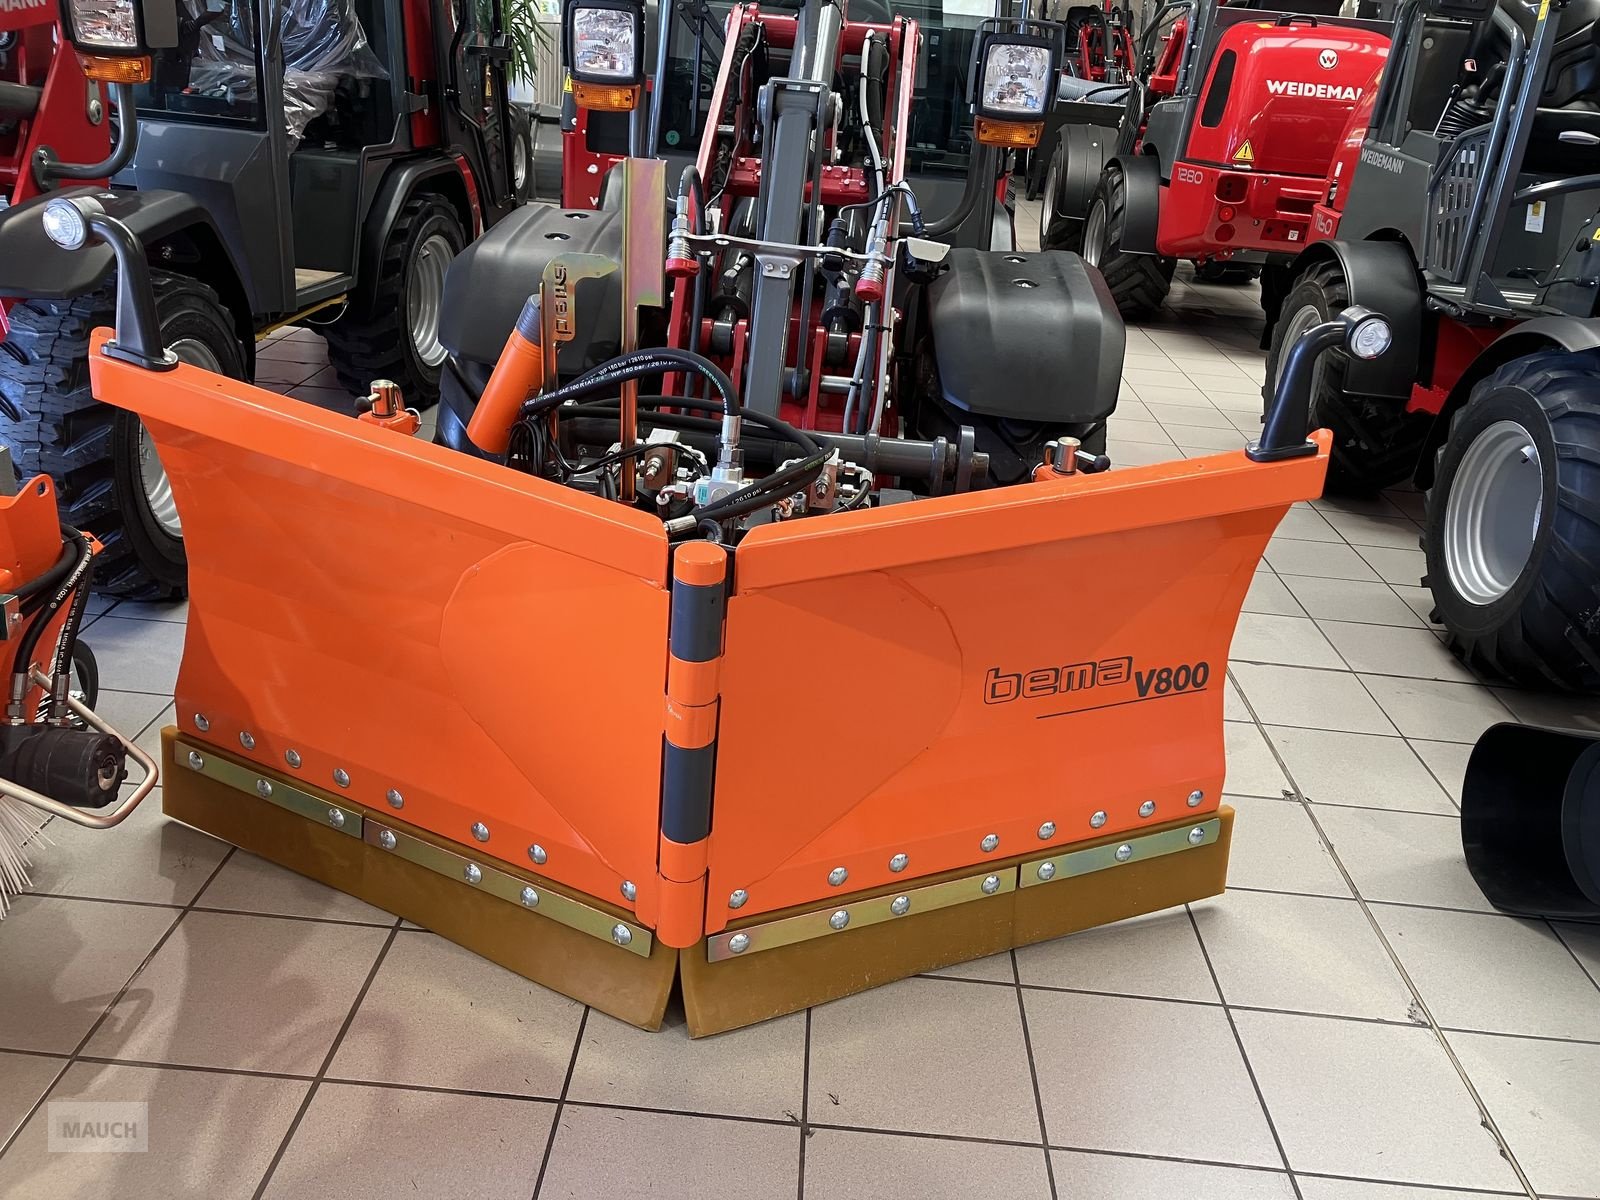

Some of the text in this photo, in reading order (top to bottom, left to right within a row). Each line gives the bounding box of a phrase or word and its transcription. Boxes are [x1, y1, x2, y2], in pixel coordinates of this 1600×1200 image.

[1362, 148, 1405, 174] WEIDEMANN
[1178, 167, 1203, 184] 1280
[983, 656, 1209, 704] bema V800
